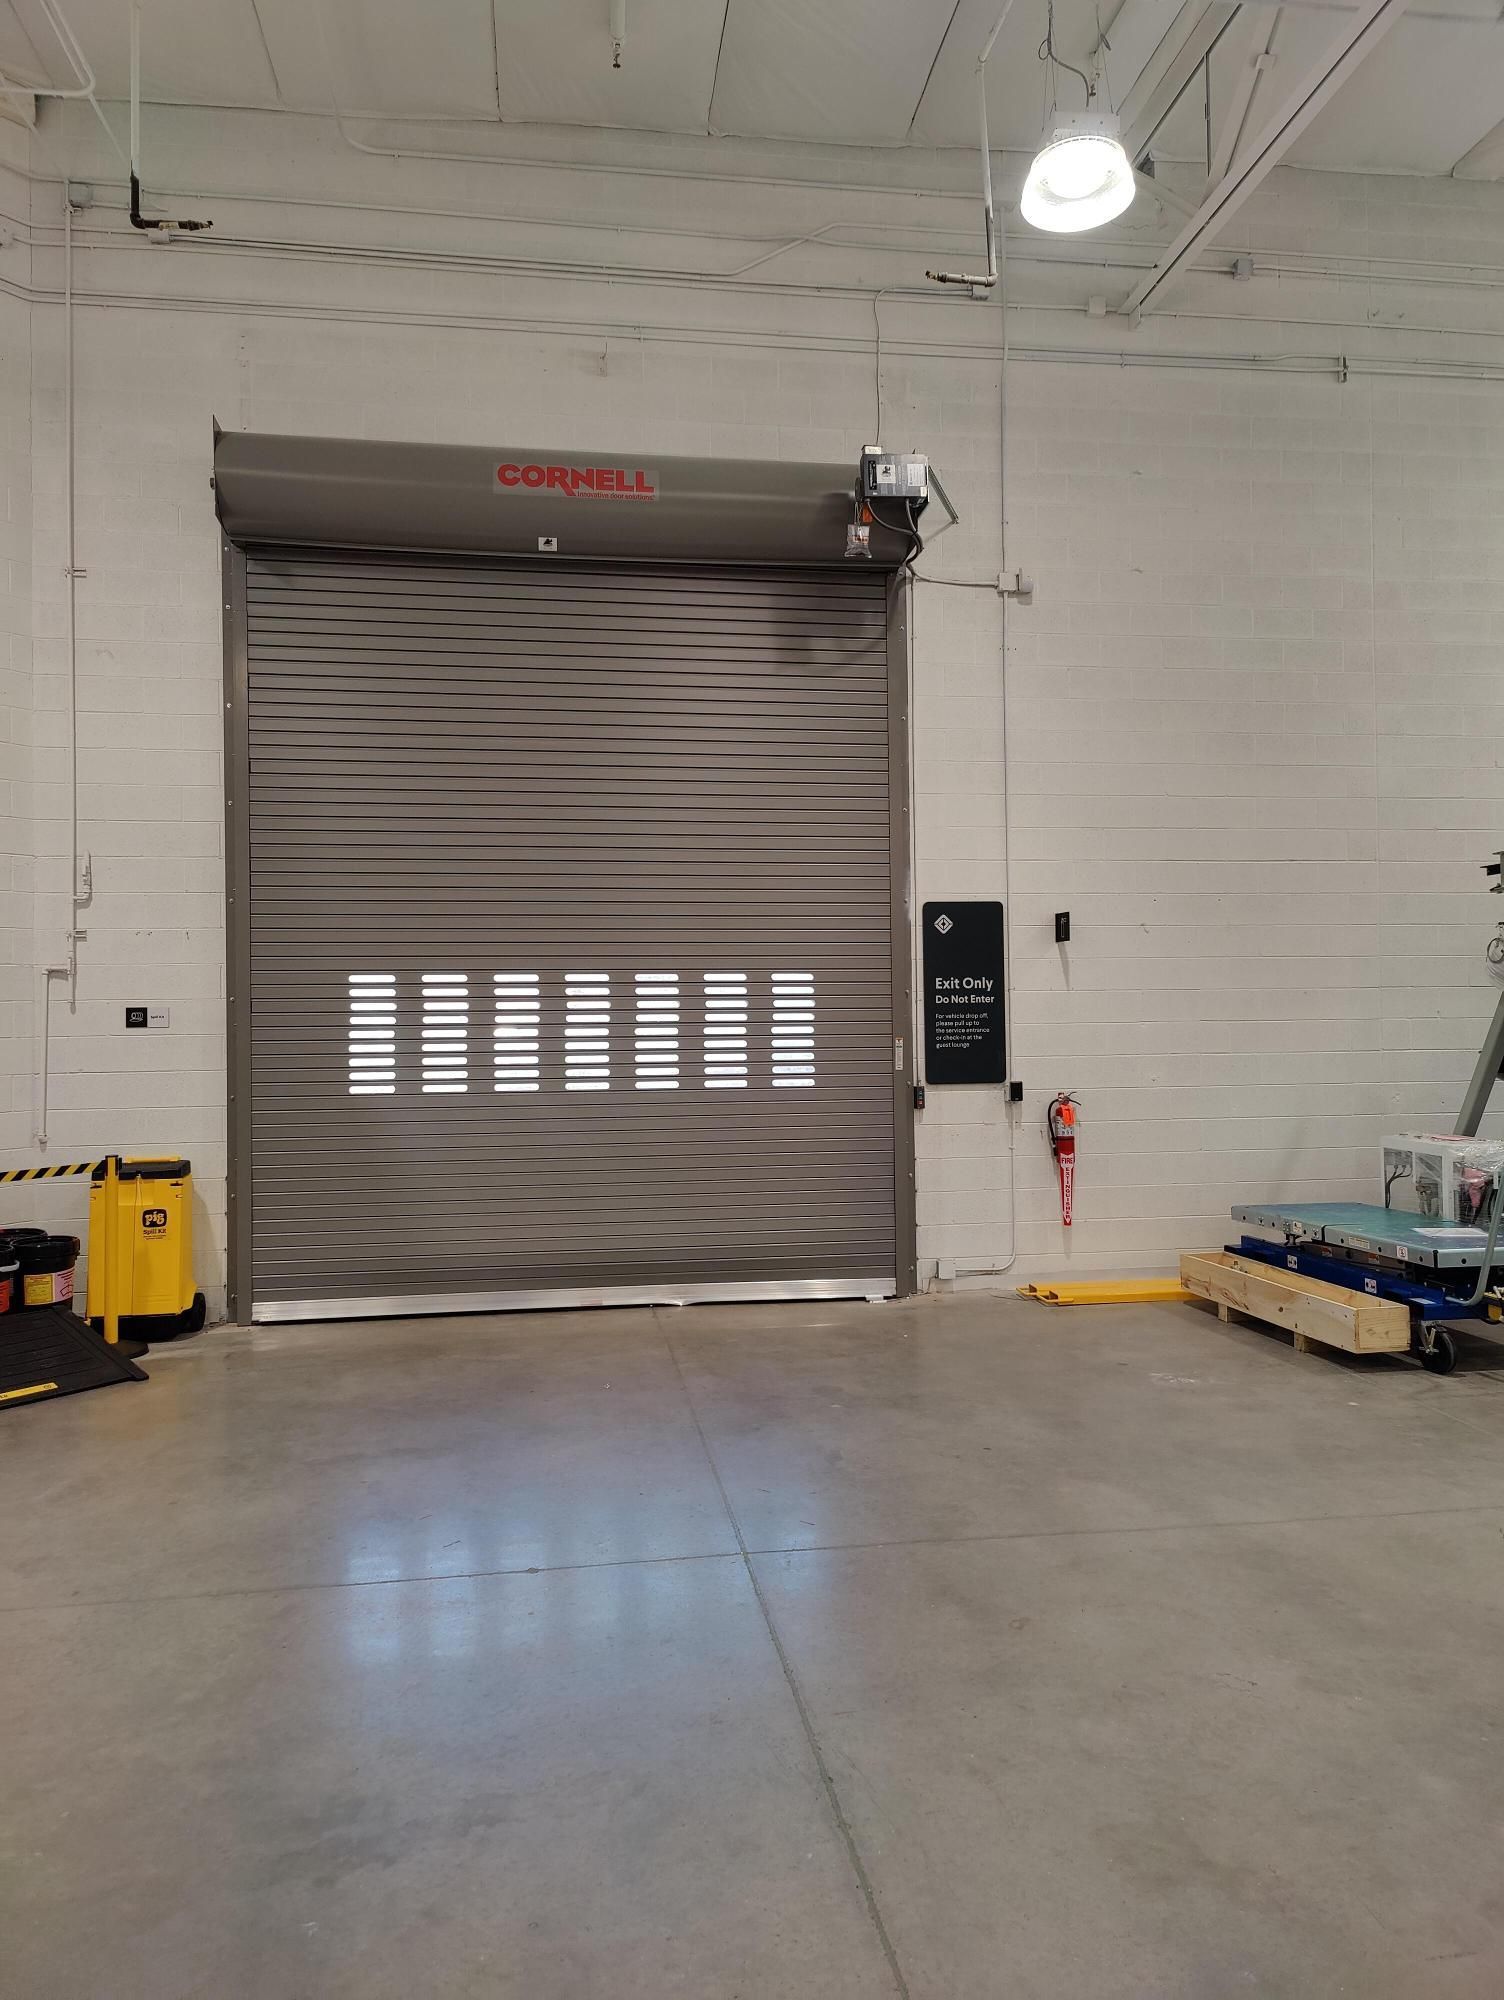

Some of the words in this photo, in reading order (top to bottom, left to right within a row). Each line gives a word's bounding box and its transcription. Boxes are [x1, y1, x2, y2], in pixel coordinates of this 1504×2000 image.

[497, 463, 654, 496] CORNELL
[935, 976, 960, 989] Exit
[962, 976, 993, 992] Only
[935, 995, 949, 1004] Do
[951, 994, 969, 1003] Not
[970, 994, 995, 1003] Enter
[965, 1012, 978, 1020] drop
[1061, 1157, 1073, 1165] FIRE
[144, 1211, 165, 1226] pig
